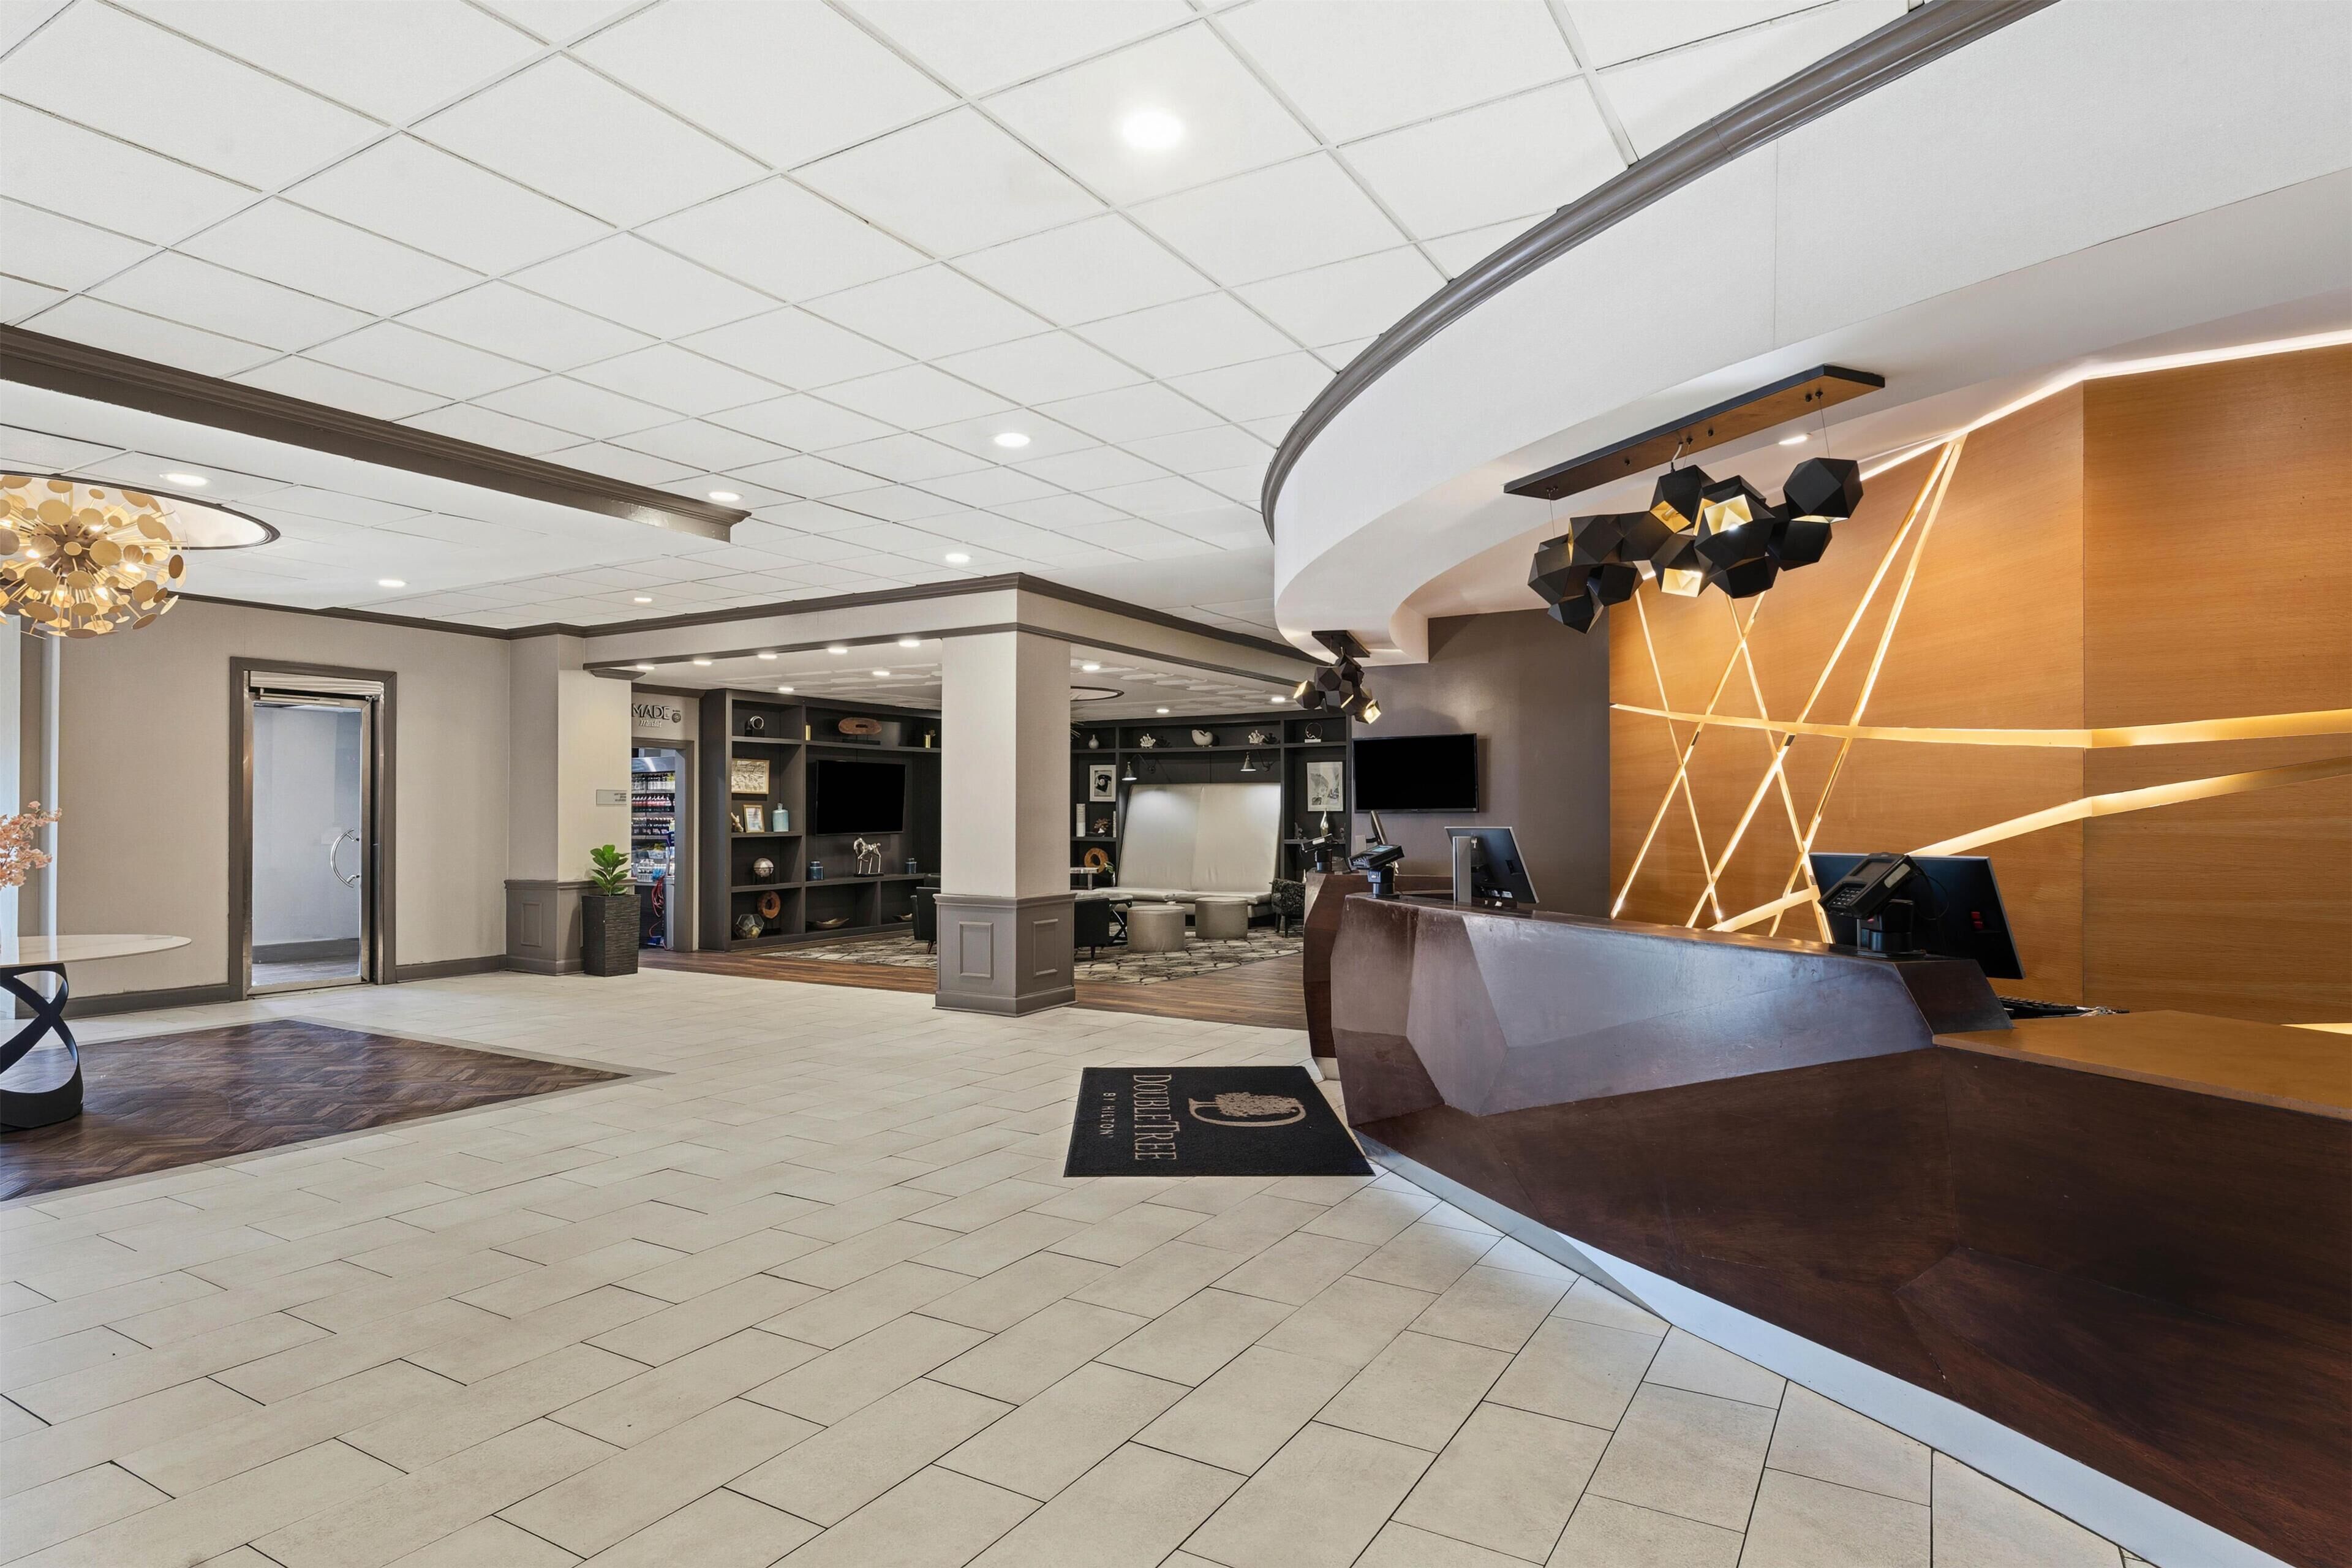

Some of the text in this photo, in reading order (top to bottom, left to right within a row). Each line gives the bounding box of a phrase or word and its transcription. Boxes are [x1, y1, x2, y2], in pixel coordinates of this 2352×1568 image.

[631, 704, 670, 720] MADE
[1099, 1092, 1116, 1138] BY HILTON
[1133, 1074, 1180, 1160] DOUBLETREE
